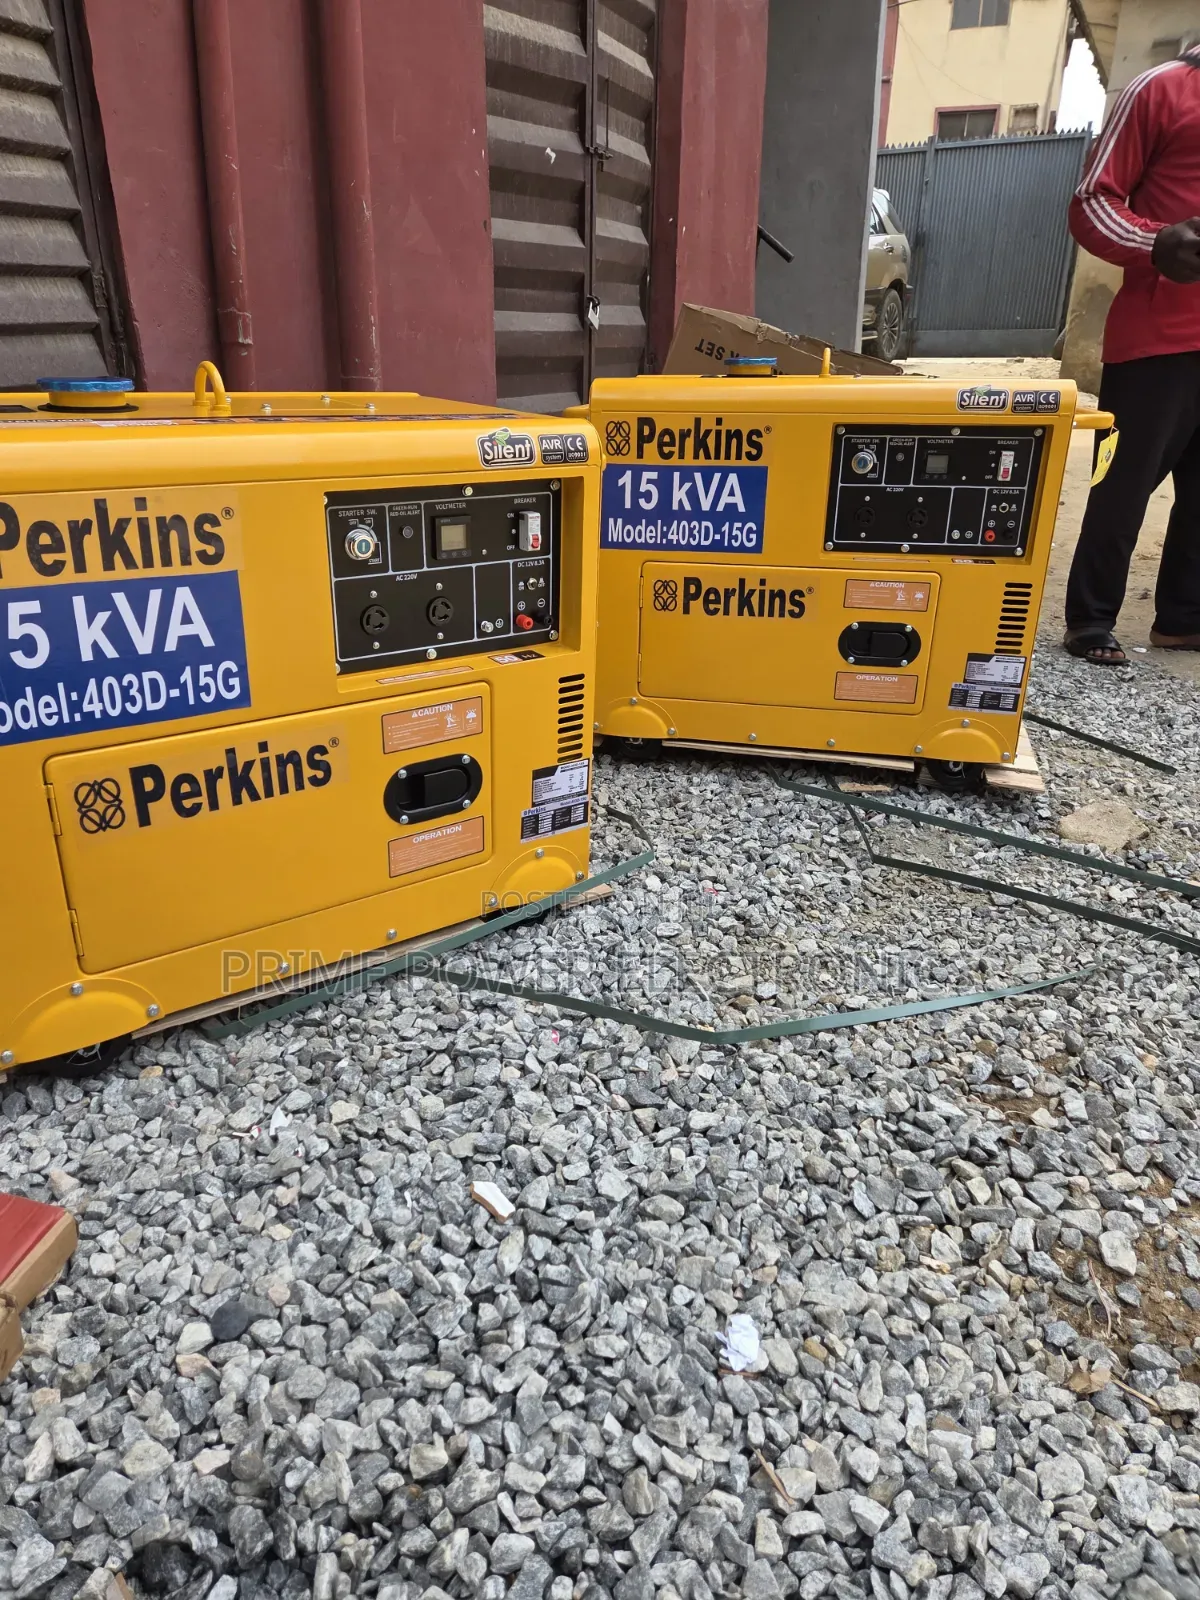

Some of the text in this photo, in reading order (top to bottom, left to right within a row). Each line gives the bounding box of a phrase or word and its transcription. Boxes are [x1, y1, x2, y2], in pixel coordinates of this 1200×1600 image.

[694, 338, 726, 361] SET
[960, 391, 1007, 406] Silent
[1014, 393, 1034, 403] AVR
[1040, 393, 1056, 404] CE
[483, 440, 531, 460] Silent
[542, 439, 562, 450] AVR
[567, 437, 584, 451] CE
[617, 470, 746, 512] 15 kVA
[435, 502, 467, 510] VOLTMETER
[338, 509, 365, 518] STARTER
[608, 517, 757, 547] Model:403D-15G
[395, 573, 418, 582] AC 220V
[72, 586, 216, 662] kVA
[418, 704, 453, 717] CAUTION
[412, 825, 462, 844] OPERATION
